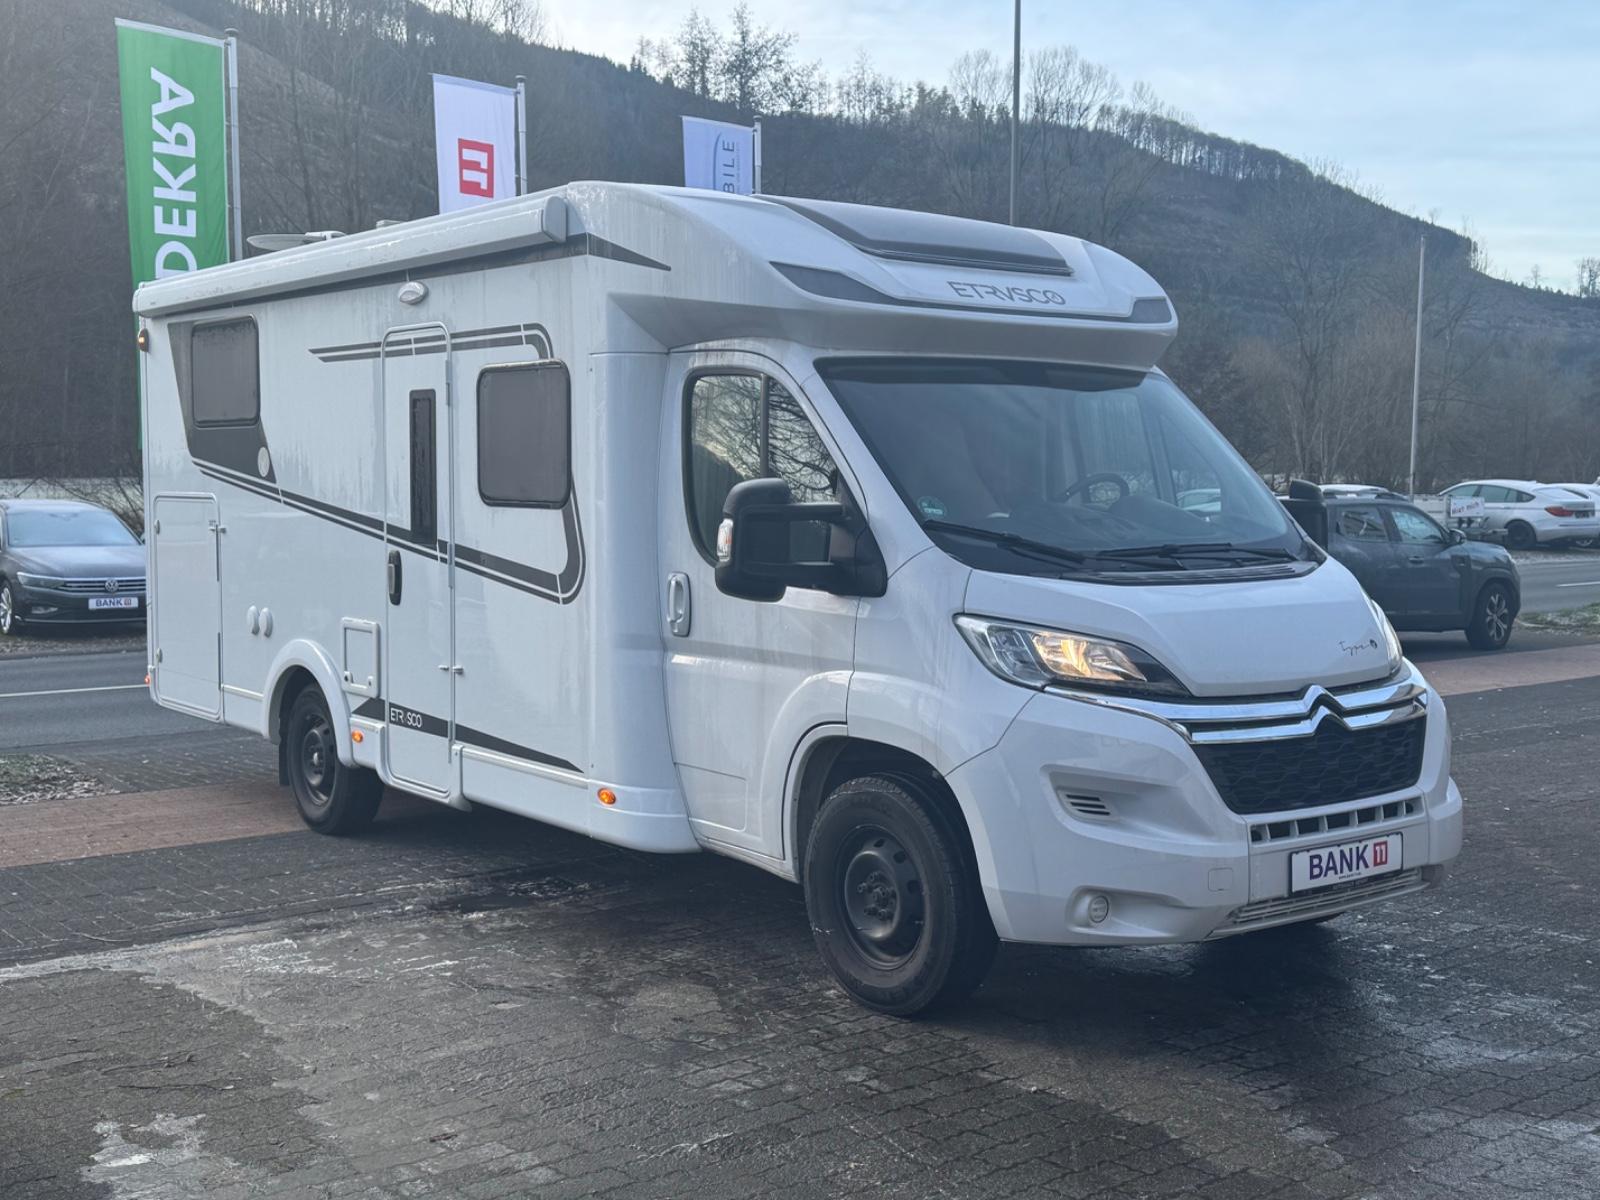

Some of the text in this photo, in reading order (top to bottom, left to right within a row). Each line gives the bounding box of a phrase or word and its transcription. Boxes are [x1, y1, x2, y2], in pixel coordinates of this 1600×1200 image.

[151, 67, 198, 280] DEKRA
[96, 599, 122, 607] BANK
[390, 707, 422, 728] ETRSCO
[1309, 843, 1387, 880] BANK 11
